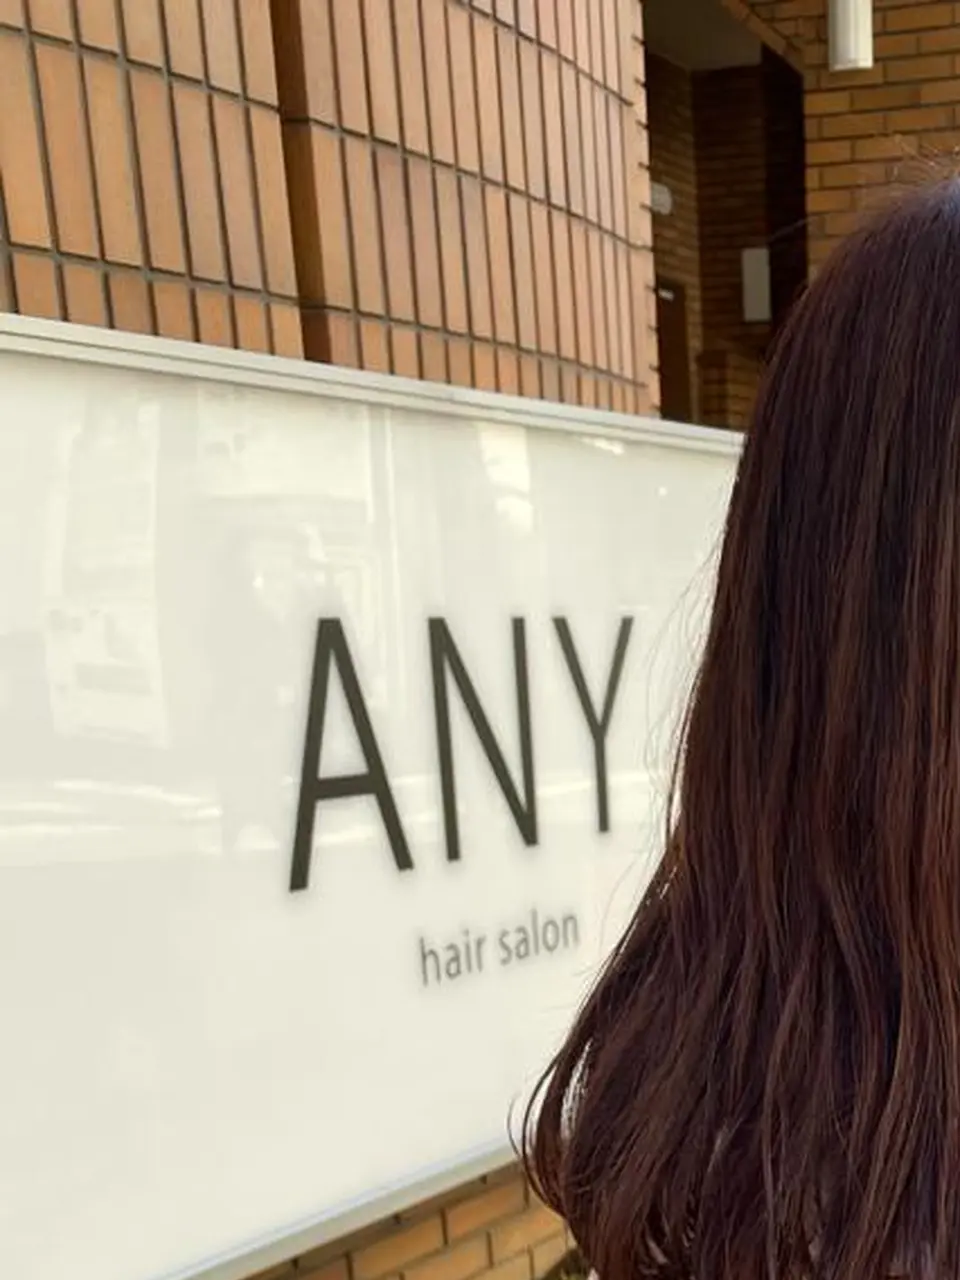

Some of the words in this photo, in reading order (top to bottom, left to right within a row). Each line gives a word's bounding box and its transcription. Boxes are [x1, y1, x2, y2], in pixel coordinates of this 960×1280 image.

[289, 617, 634, 891] ANY
[419, 929, 487, 986] hair
[498, 909, 579, 965] salon
